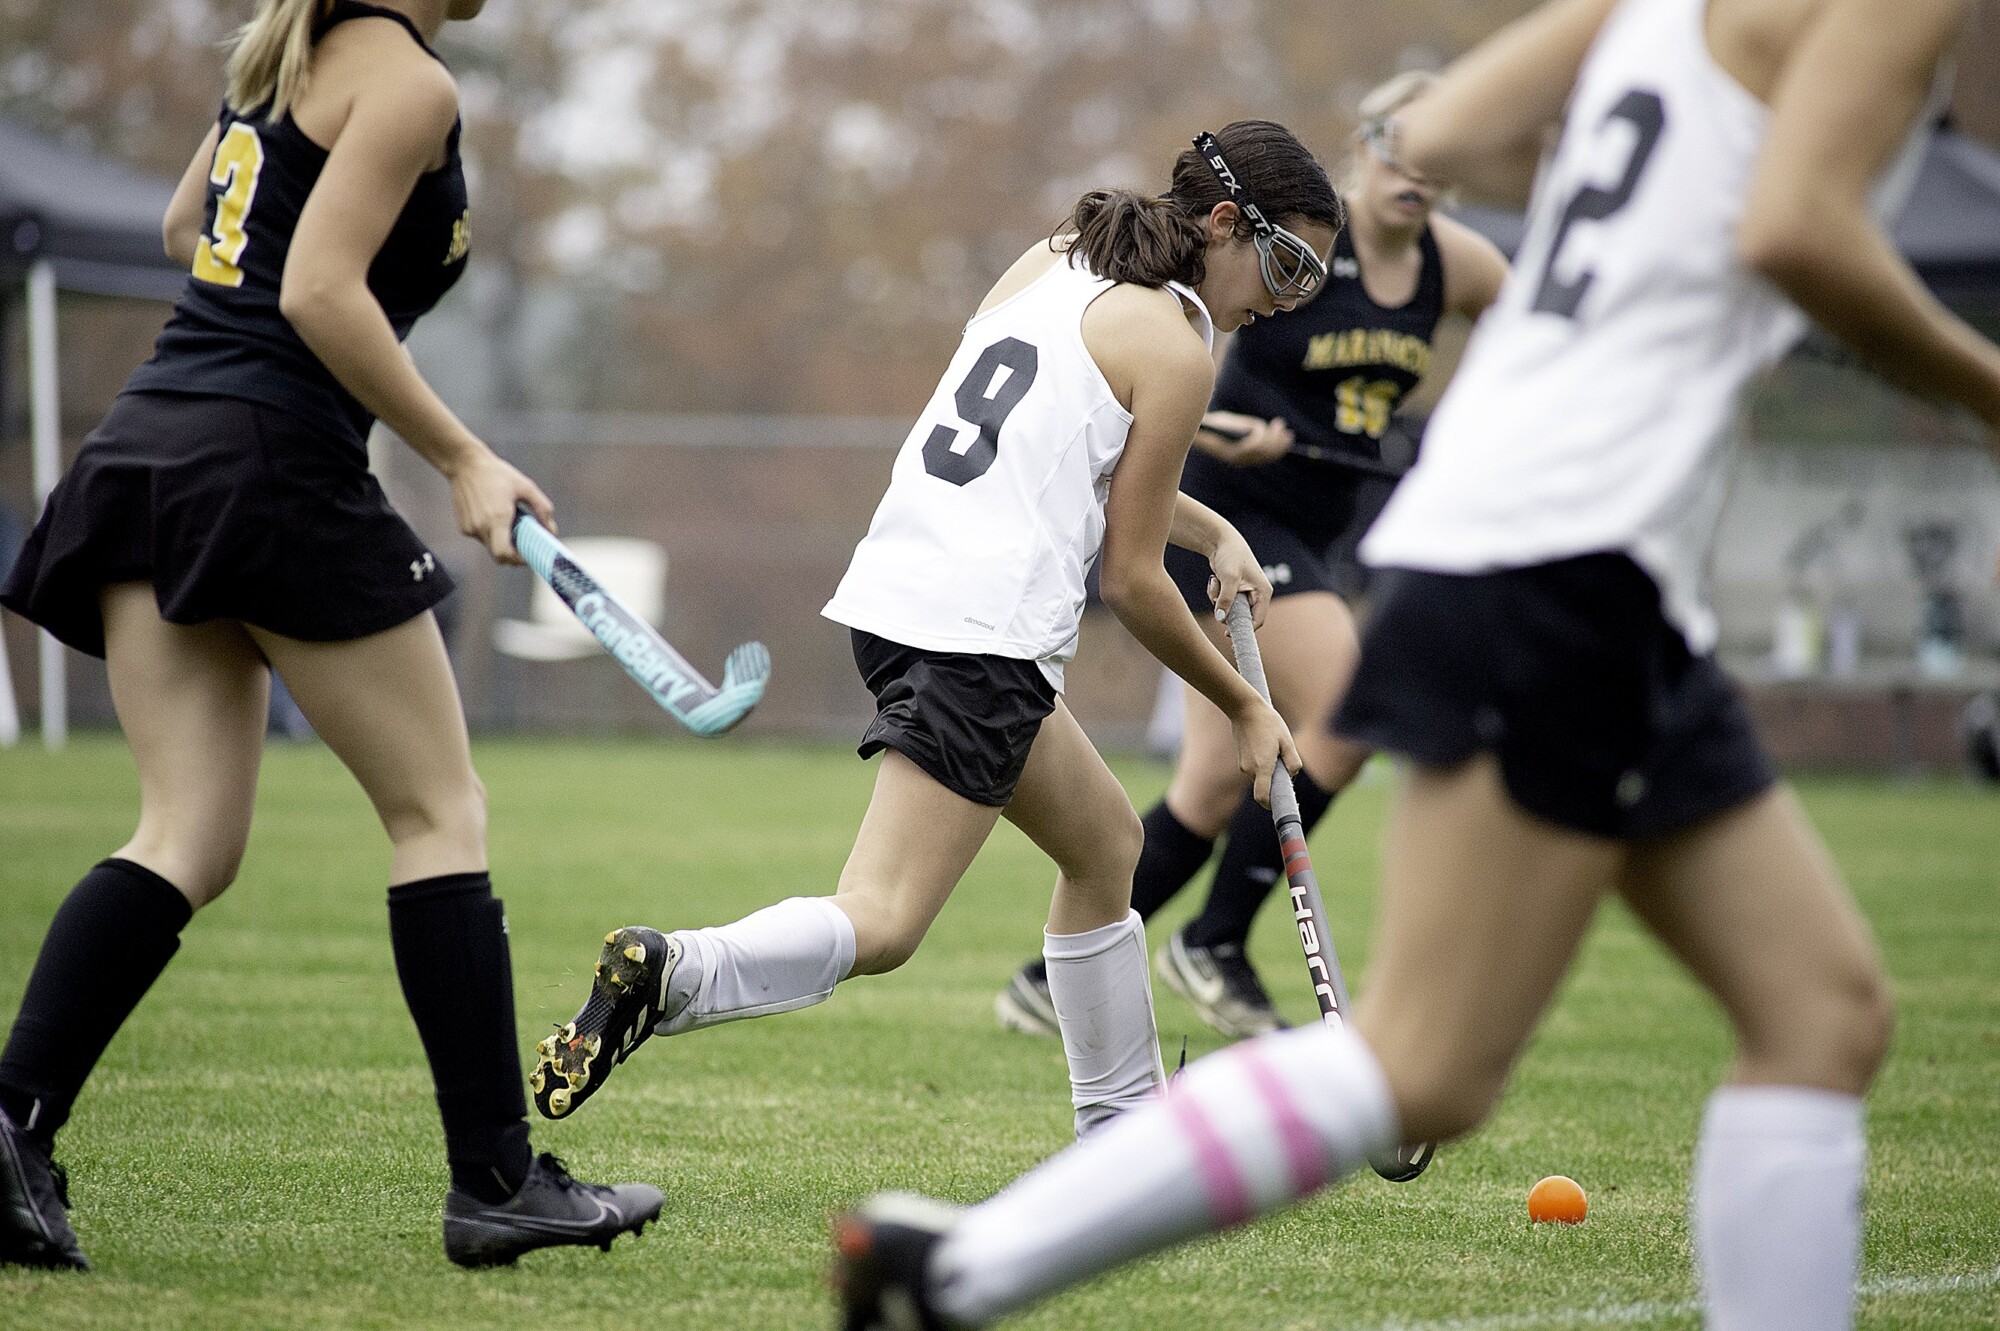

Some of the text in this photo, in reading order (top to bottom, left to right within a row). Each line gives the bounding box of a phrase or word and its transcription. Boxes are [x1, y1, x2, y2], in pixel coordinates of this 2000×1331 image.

[1209, 155, 1241, 195] STX
[1242, 203, 1272, 236] ST
[1530, 90, 1665, 318] 2
[922, 336, 1038, 487] 9
[574, 592, 697, 703] CranBarry
